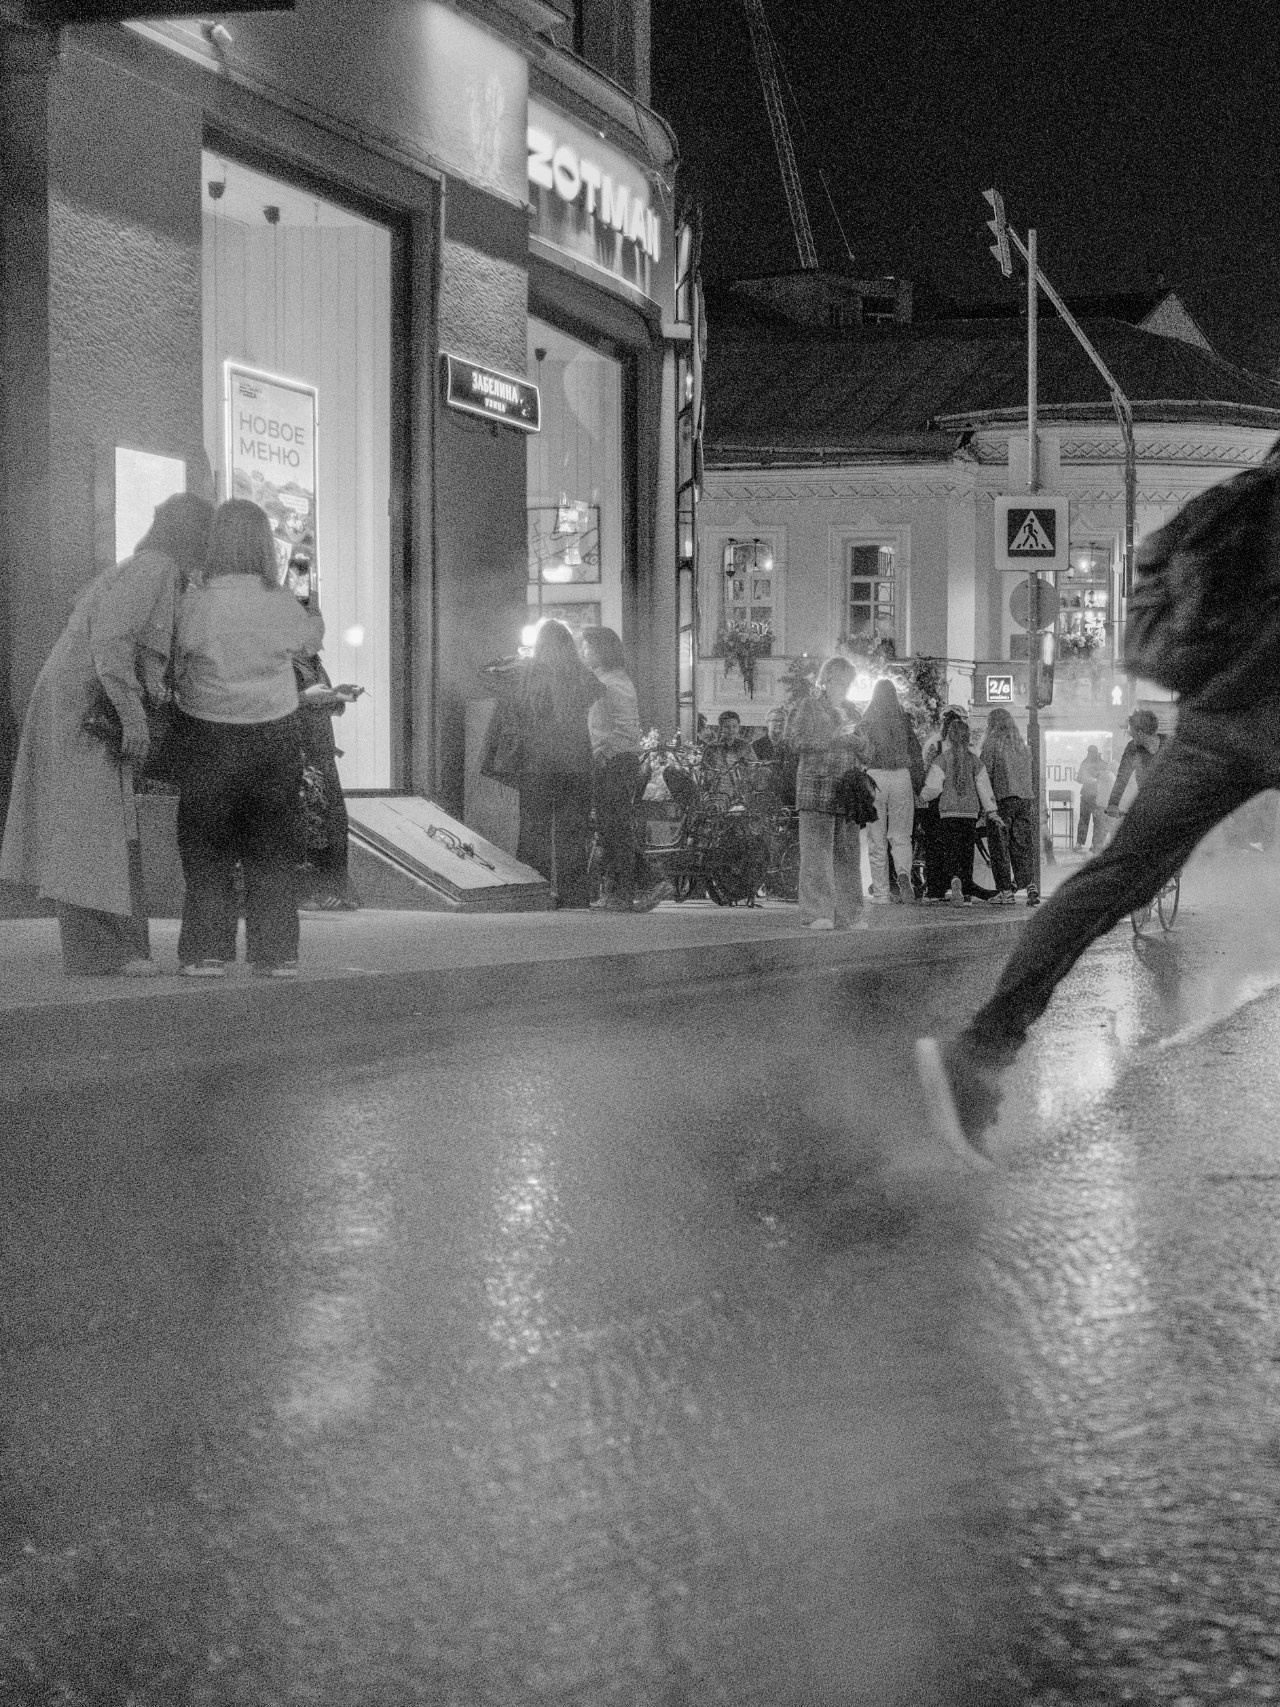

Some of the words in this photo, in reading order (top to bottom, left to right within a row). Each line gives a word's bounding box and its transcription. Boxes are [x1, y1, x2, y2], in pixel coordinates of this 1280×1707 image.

[528, 126, 659, 262] ZOTMAN
[472, 371, 519, 404] ЗАБЕЛИНА
[239, 411, 305, 445] НОВОЕ
[239, 436, 301, 468] МЕНЮ
